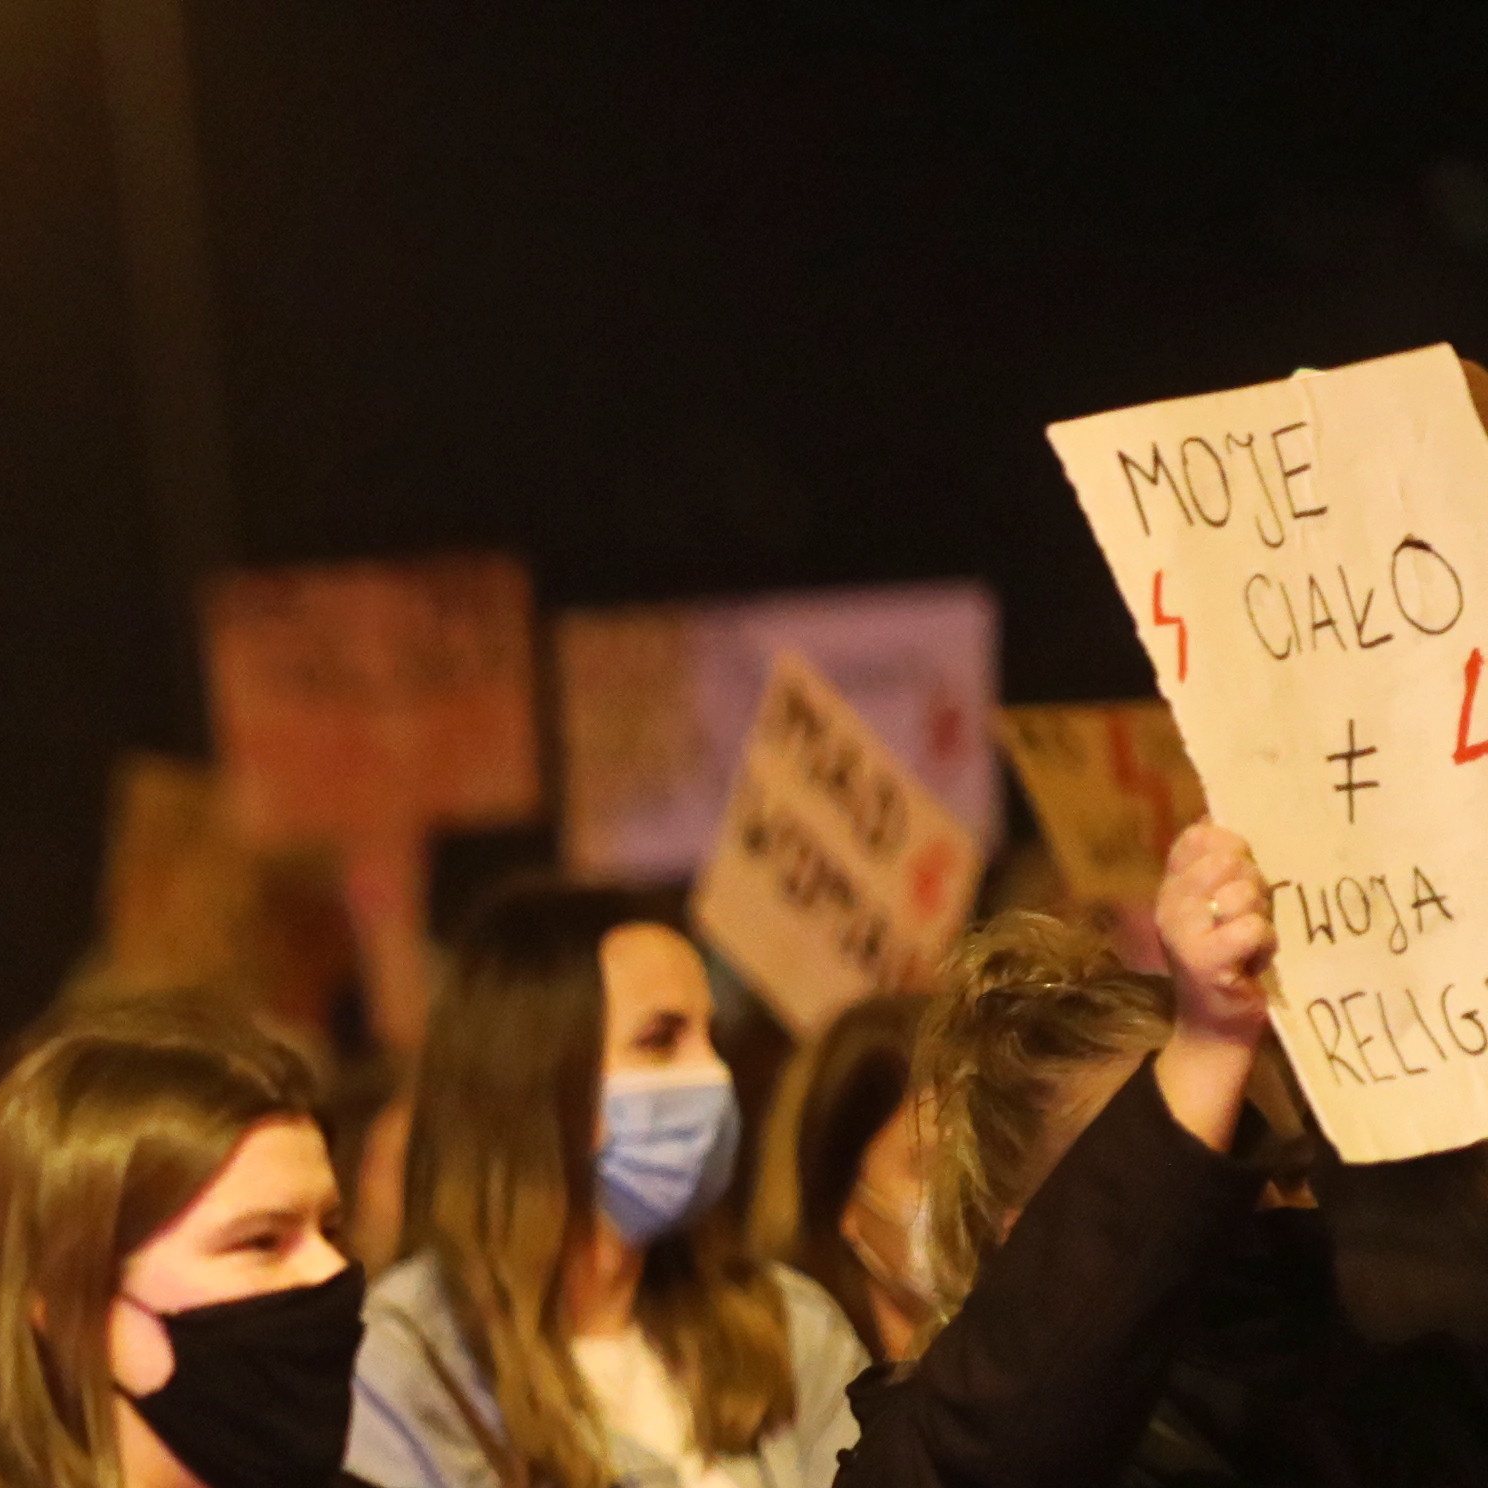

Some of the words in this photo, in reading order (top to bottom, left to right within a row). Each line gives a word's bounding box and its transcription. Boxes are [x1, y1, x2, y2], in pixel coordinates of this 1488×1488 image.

[1117, 420, 1329, 550] MOJE
[1243, 533, 1464, 662] CIAŁO
[1306, 977, 1488, 1087] RELIG
